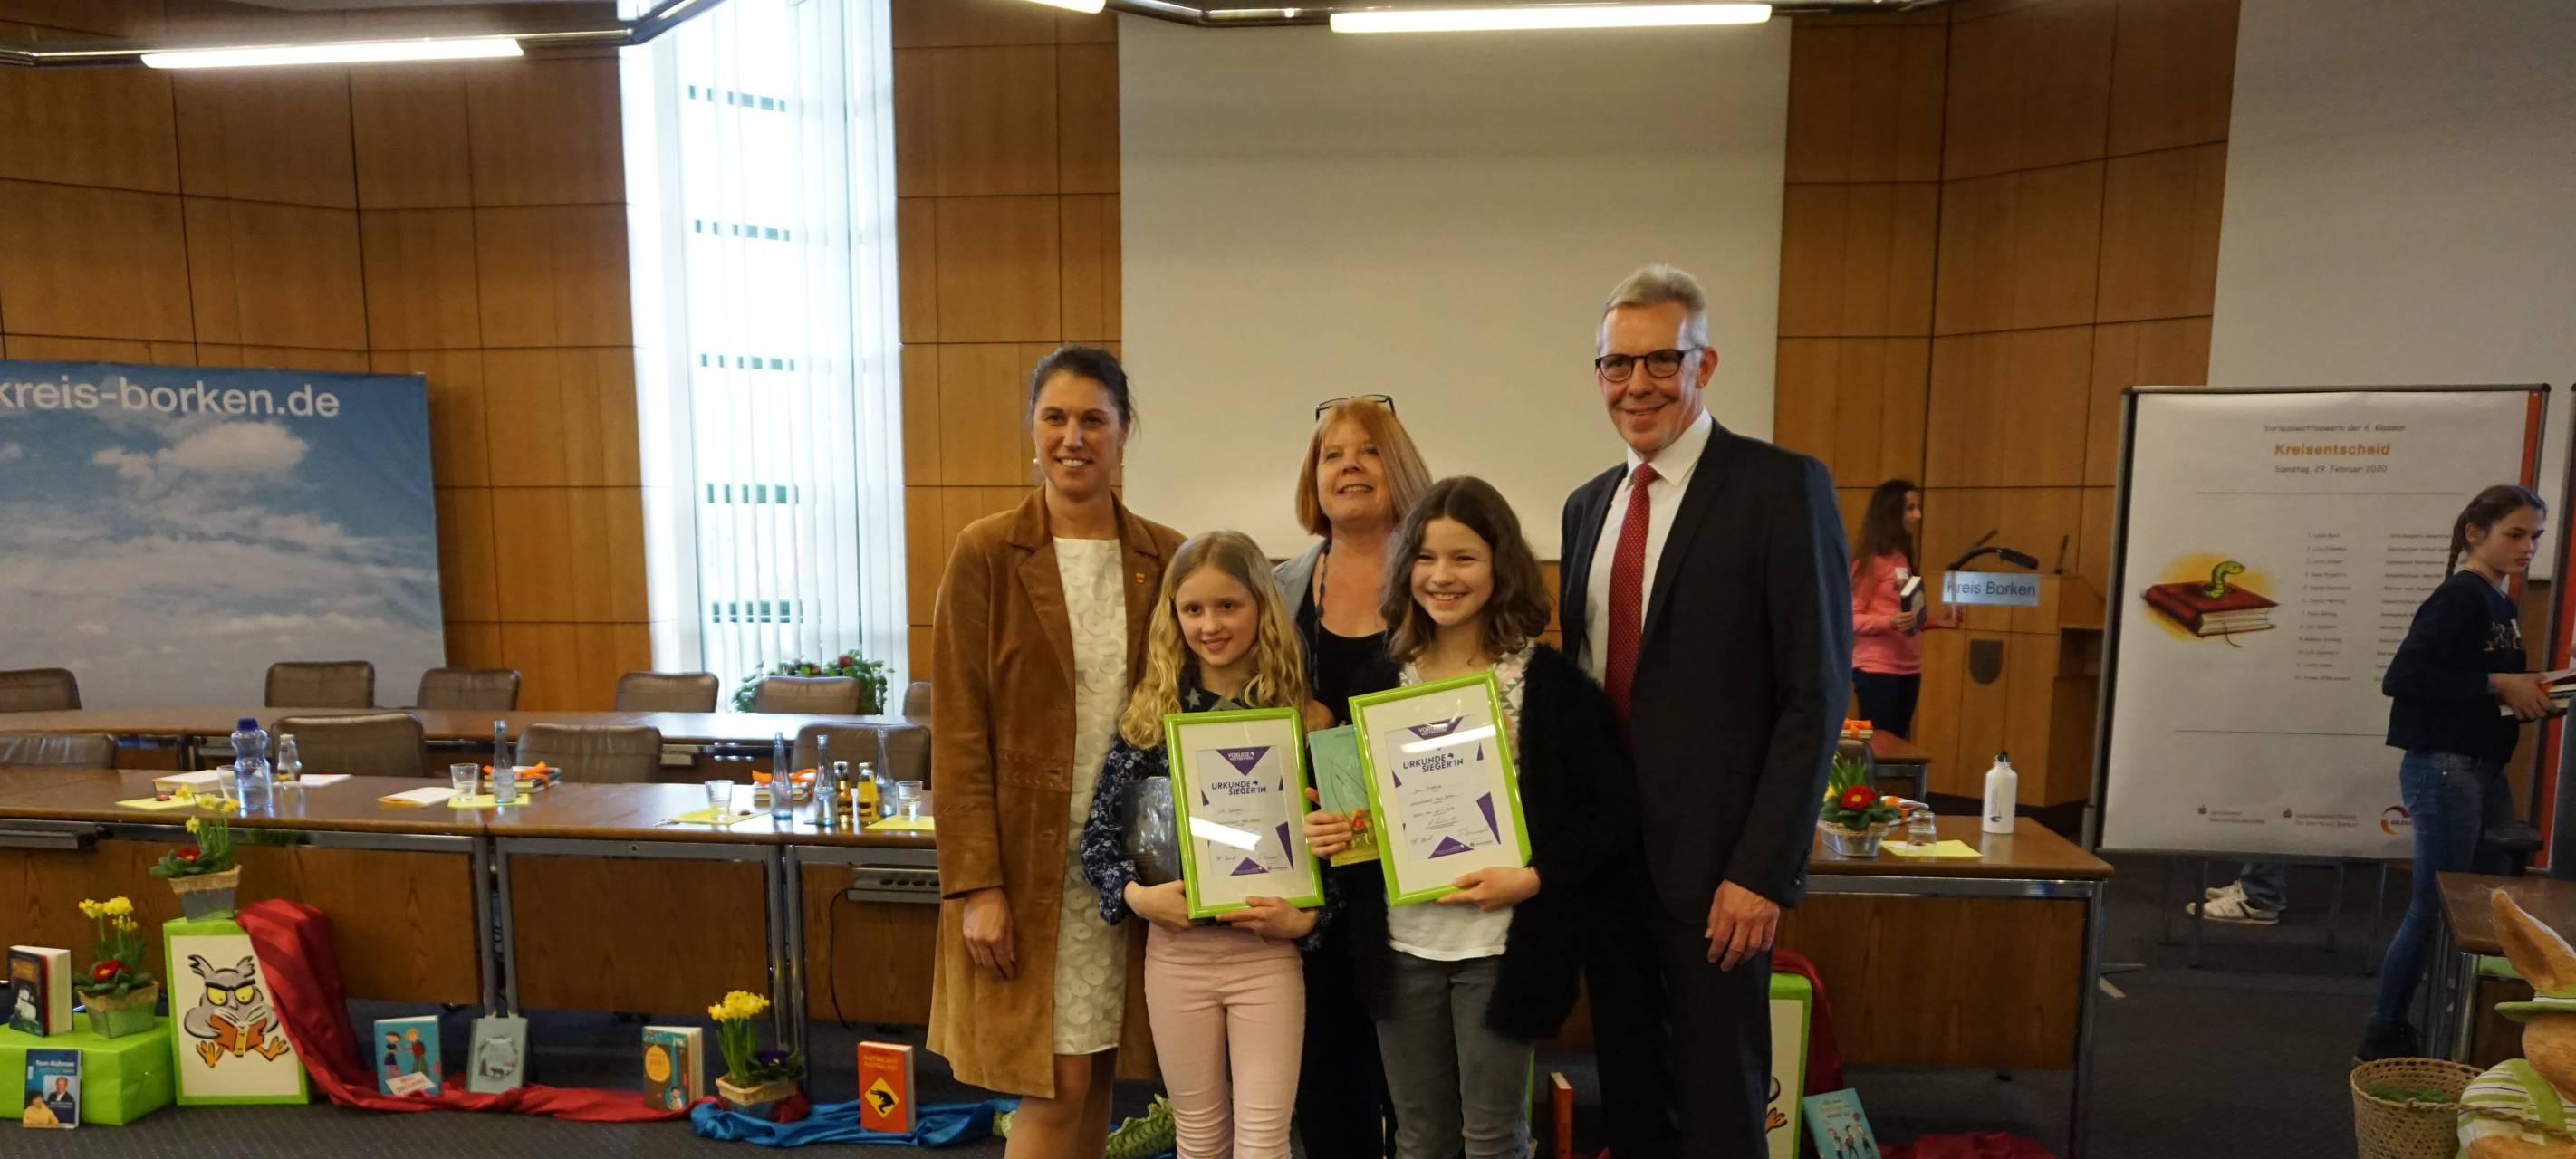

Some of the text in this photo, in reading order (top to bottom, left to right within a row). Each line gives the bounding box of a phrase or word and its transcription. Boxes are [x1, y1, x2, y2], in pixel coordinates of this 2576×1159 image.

[2348, 424, 2361, 432] der
[2274, 443, 2391, 455] Kreisentscheid
[1986, 580, 2035, 596] Borken
[1403, 754, 1446, 769] URKUNDE
[1211, 781, 1251, 790] URKUNDE
